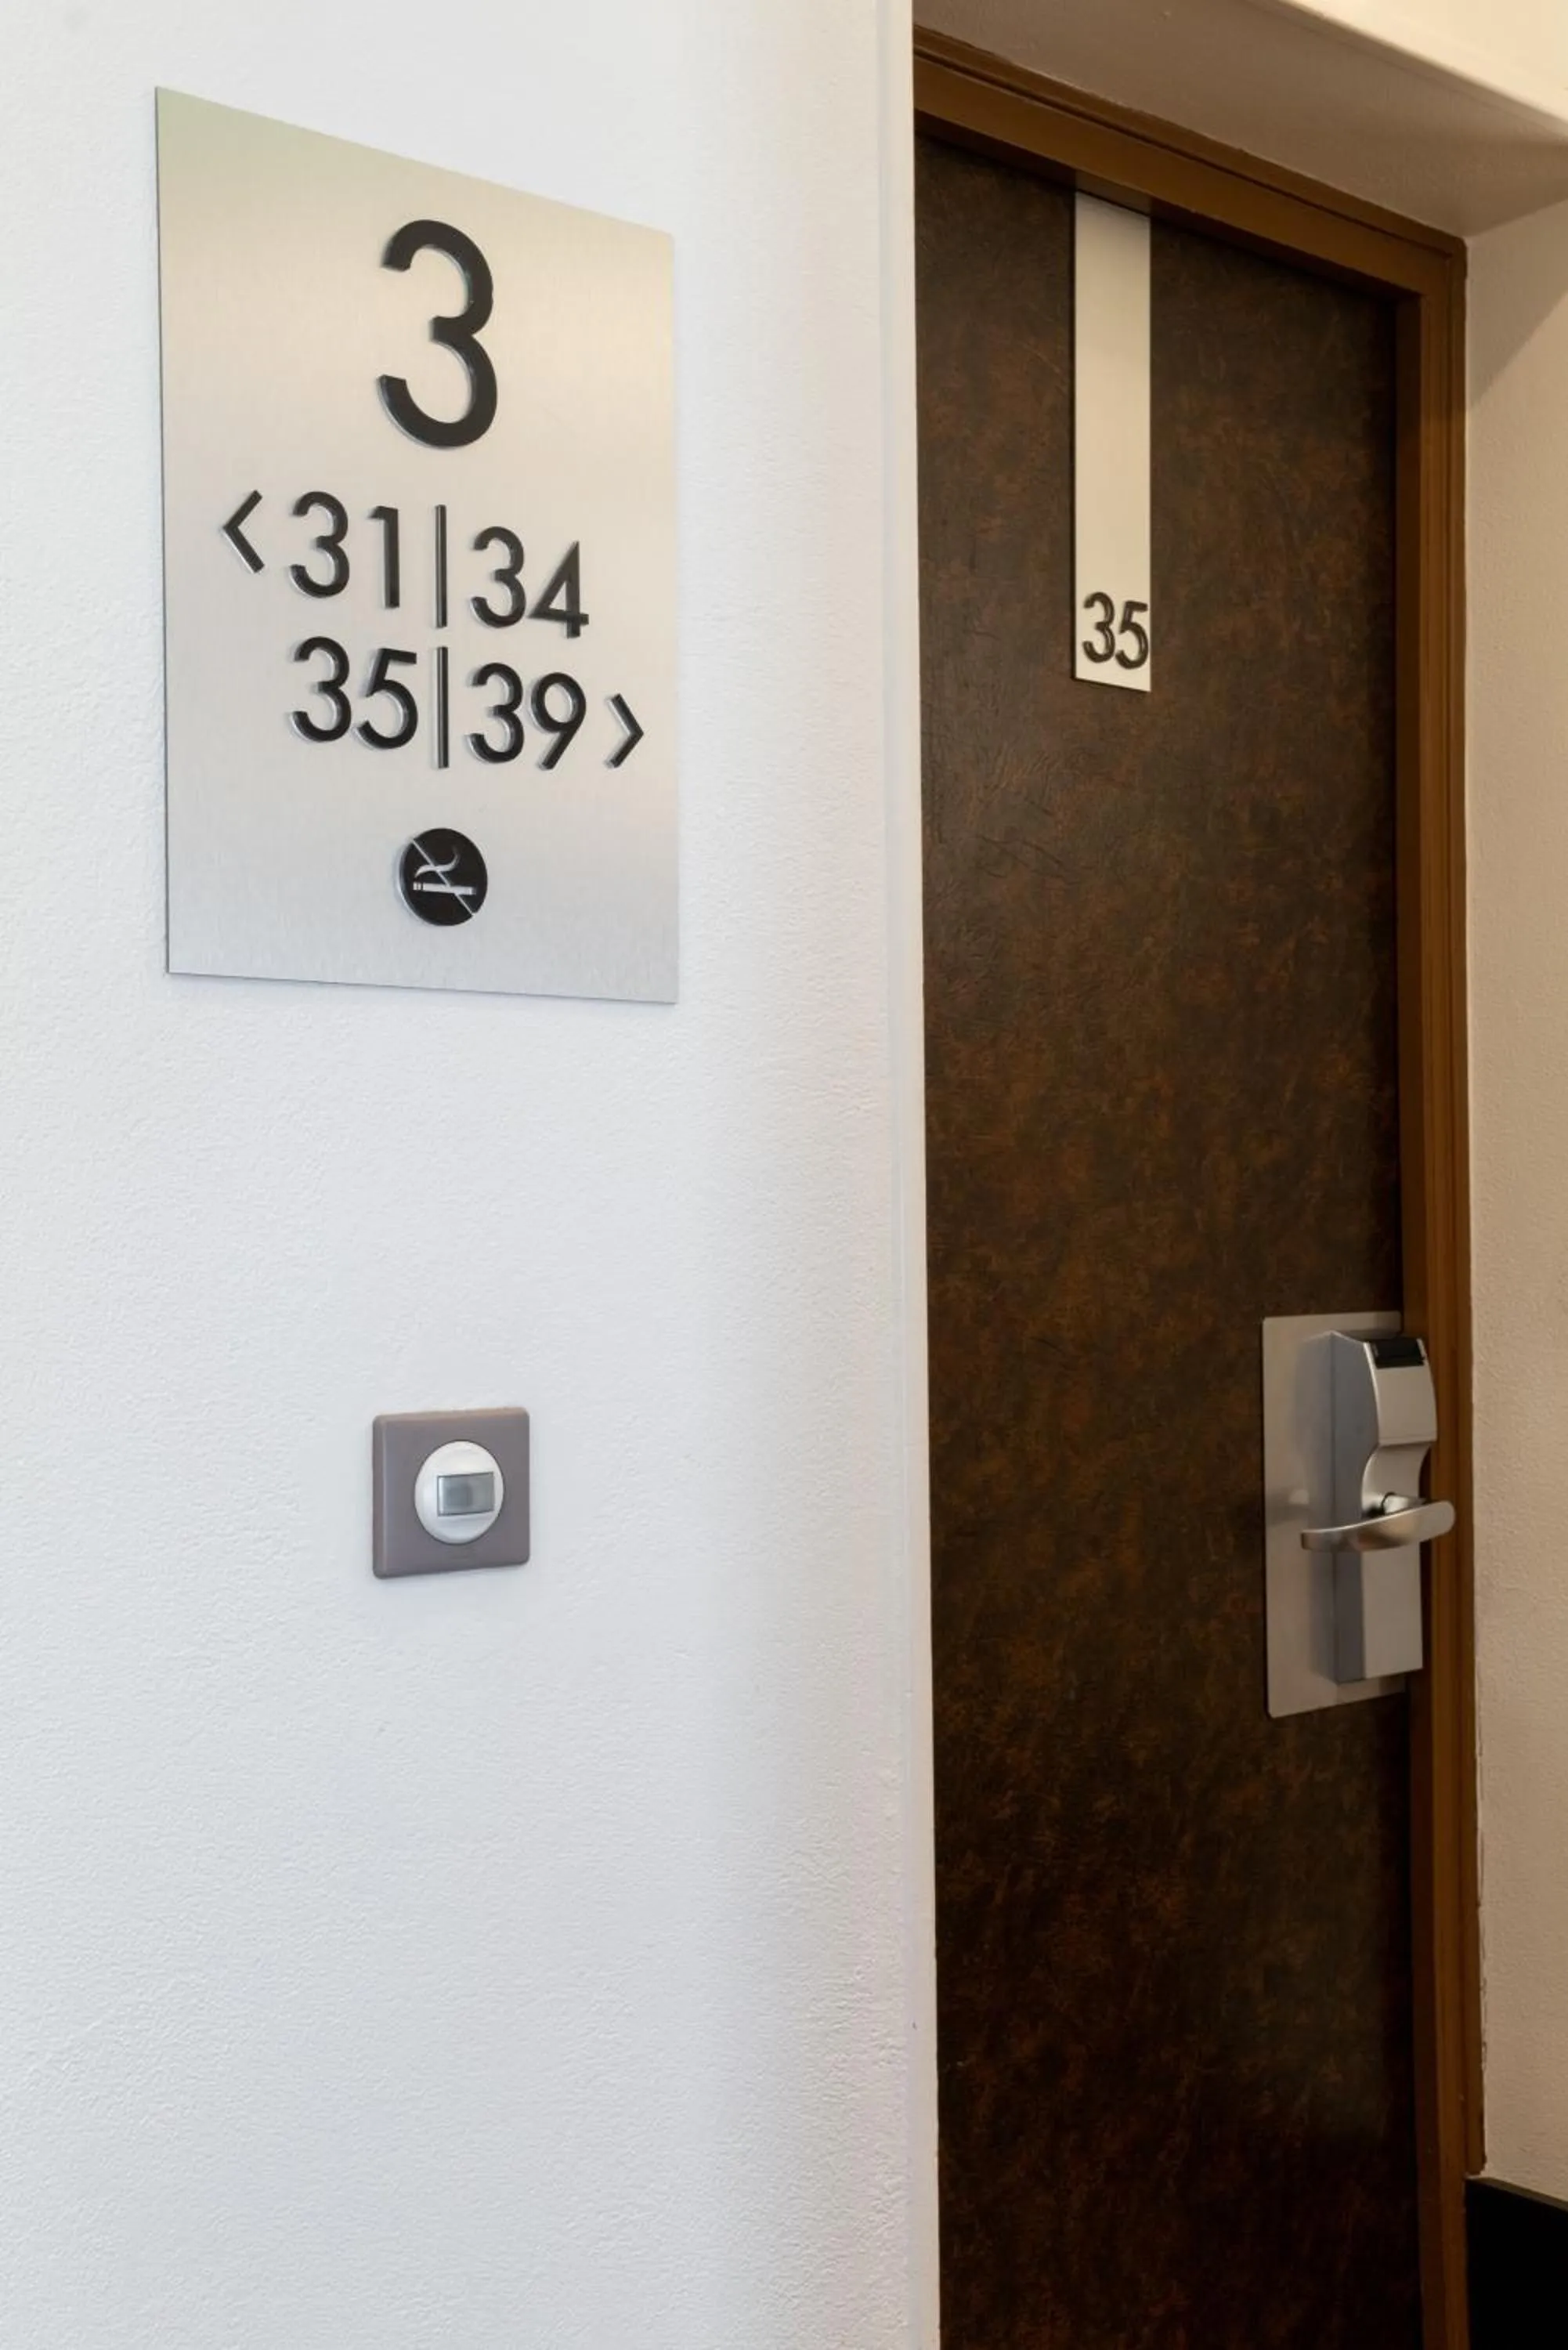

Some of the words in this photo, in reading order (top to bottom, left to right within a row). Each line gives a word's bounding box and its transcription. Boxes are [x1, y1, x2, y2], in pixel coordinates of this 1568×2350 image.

[377, 219, 498, 448] 3
[289, 490, 400, 609] 31
[470, 526, 590, 639] 34
[1082, 591, 1149, 670] 35
[292, 634, 419, 750] 35
[468, 662, 587, 772] 39
